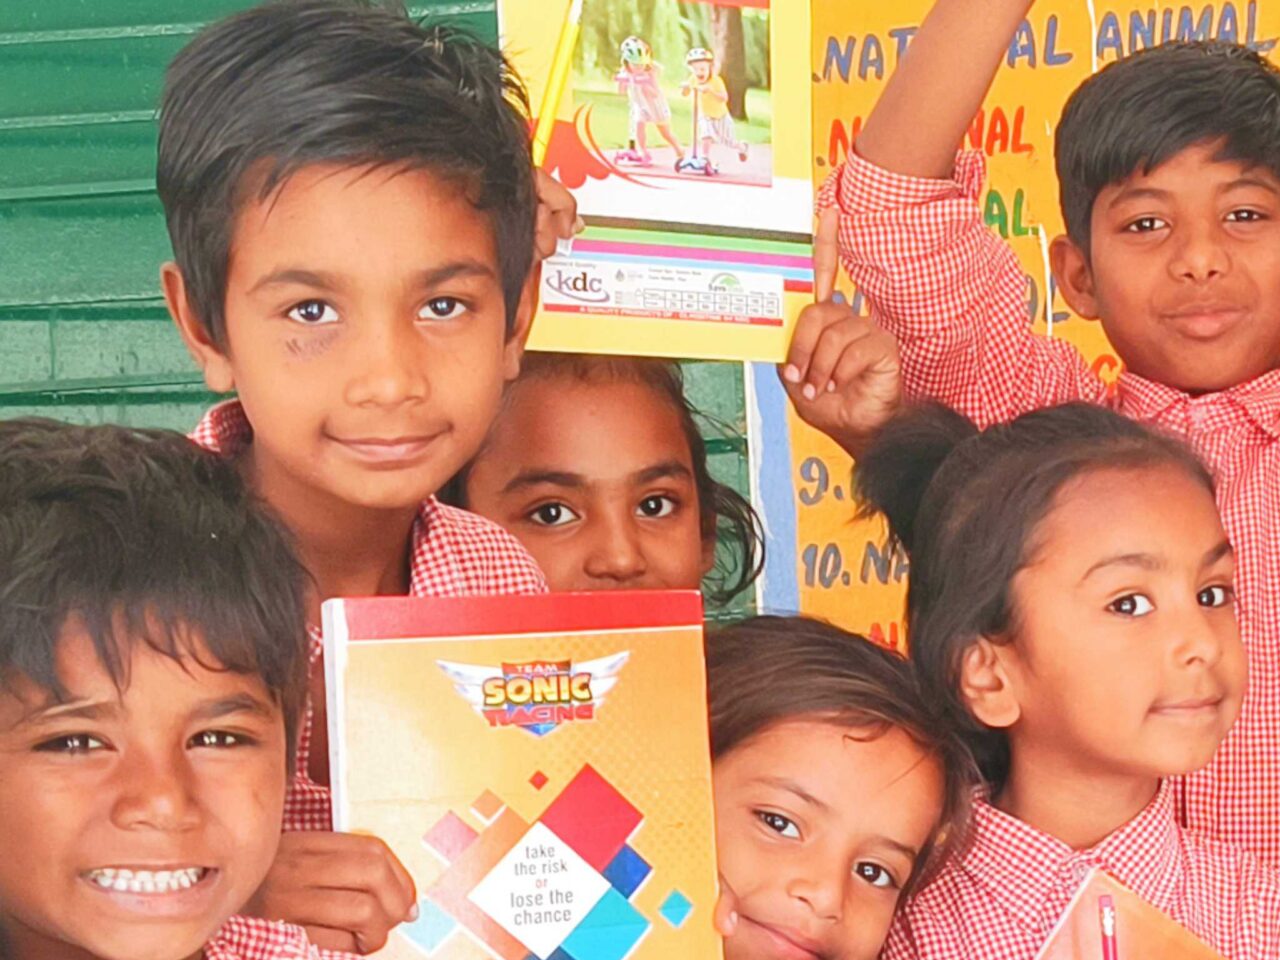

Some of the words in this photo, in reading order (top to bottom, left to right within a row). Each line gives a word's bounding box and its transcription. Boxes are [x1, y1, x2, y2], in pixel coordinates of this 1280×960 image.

[556, 270, 602, 293] kdc
[516, 664, 559, 674] TEAM
[483, 673, 592, 706] SONIC
[526, 844, 555, 859] take
[514, 862, 537, 876] the
[542, 859, 568, 874] risk
[535, 878, 548, 889] or
[510, 892, 543, 908] lose
[550, 889, 574, 905] the
[514, 909, 572, 925] chance
